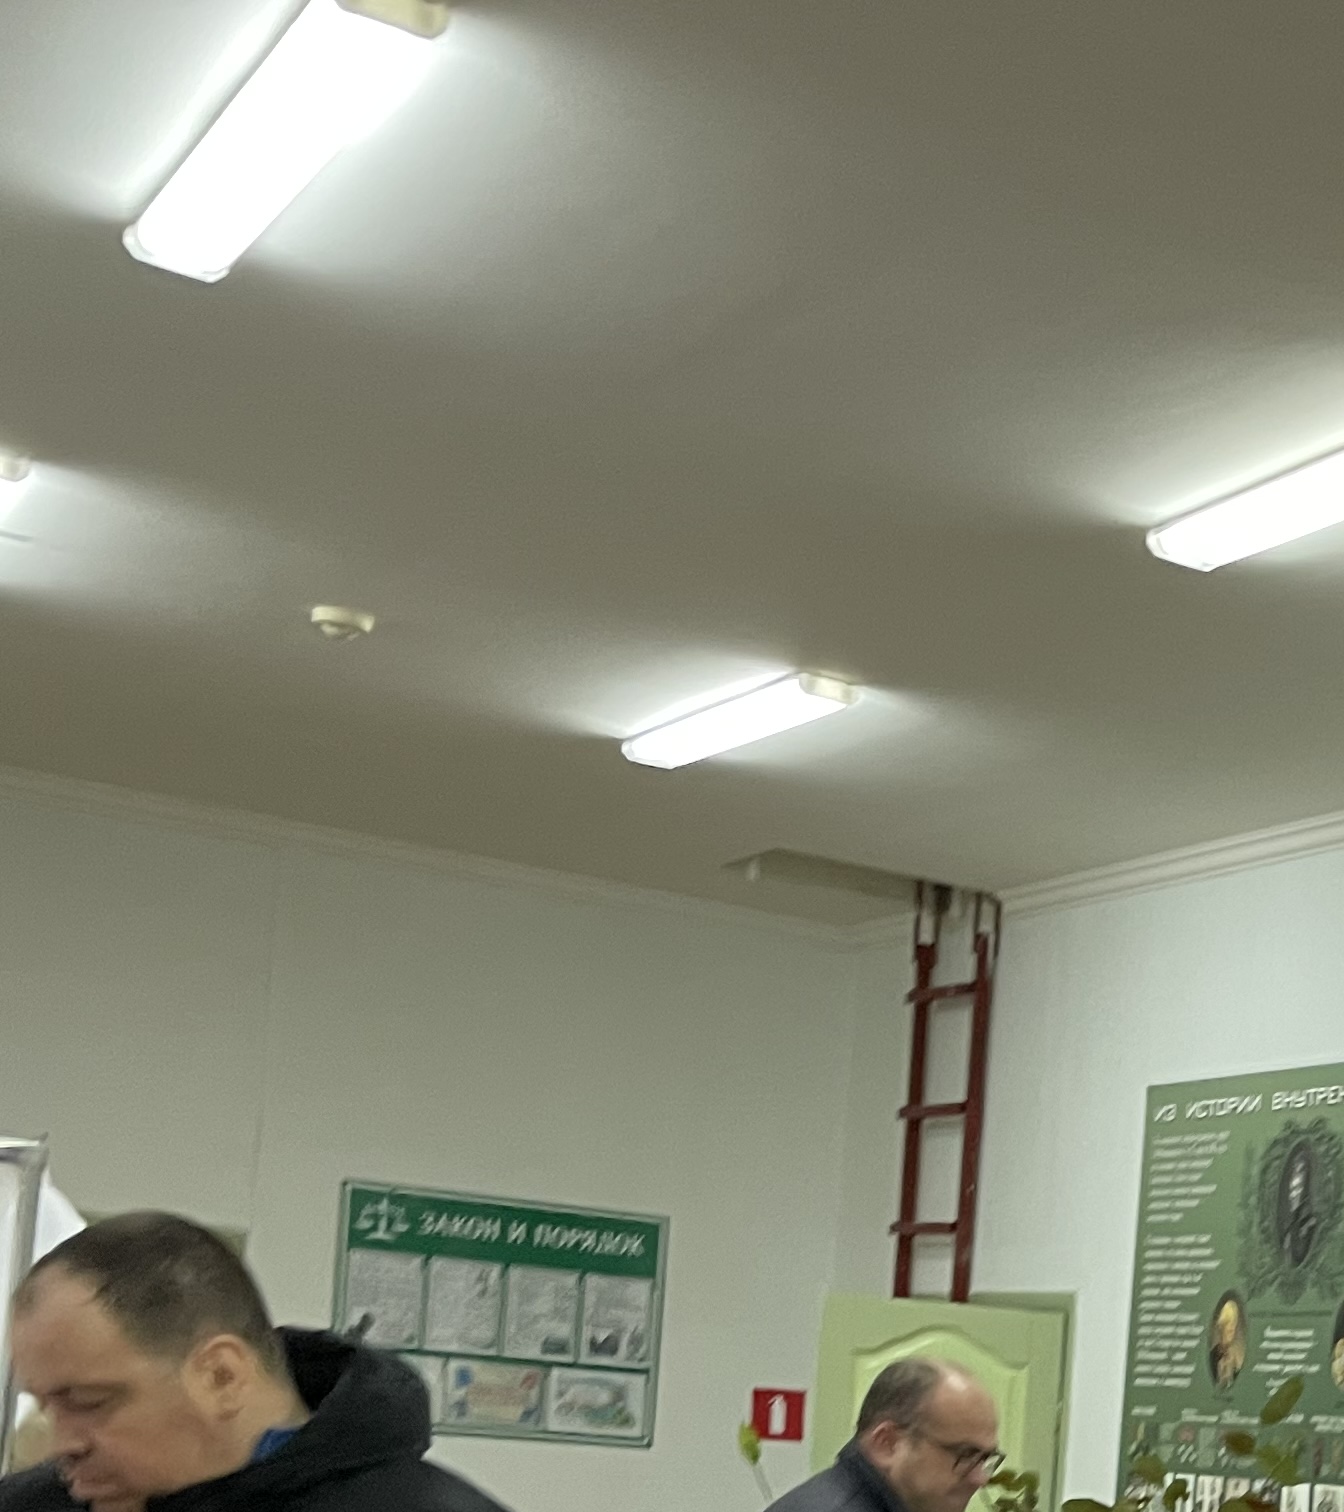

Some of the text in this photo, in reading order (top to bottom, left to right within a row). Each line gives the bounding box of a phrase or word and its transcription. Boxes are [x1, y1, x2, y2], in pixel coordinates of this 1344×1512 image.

[1153, 1103, 1177, 1122] ИЗ
[1185, 1094, 1262, 1120] ИСТОРИИ
[417, 1211, 645, 1258] ЗАКОН И ПОРЯДОК
